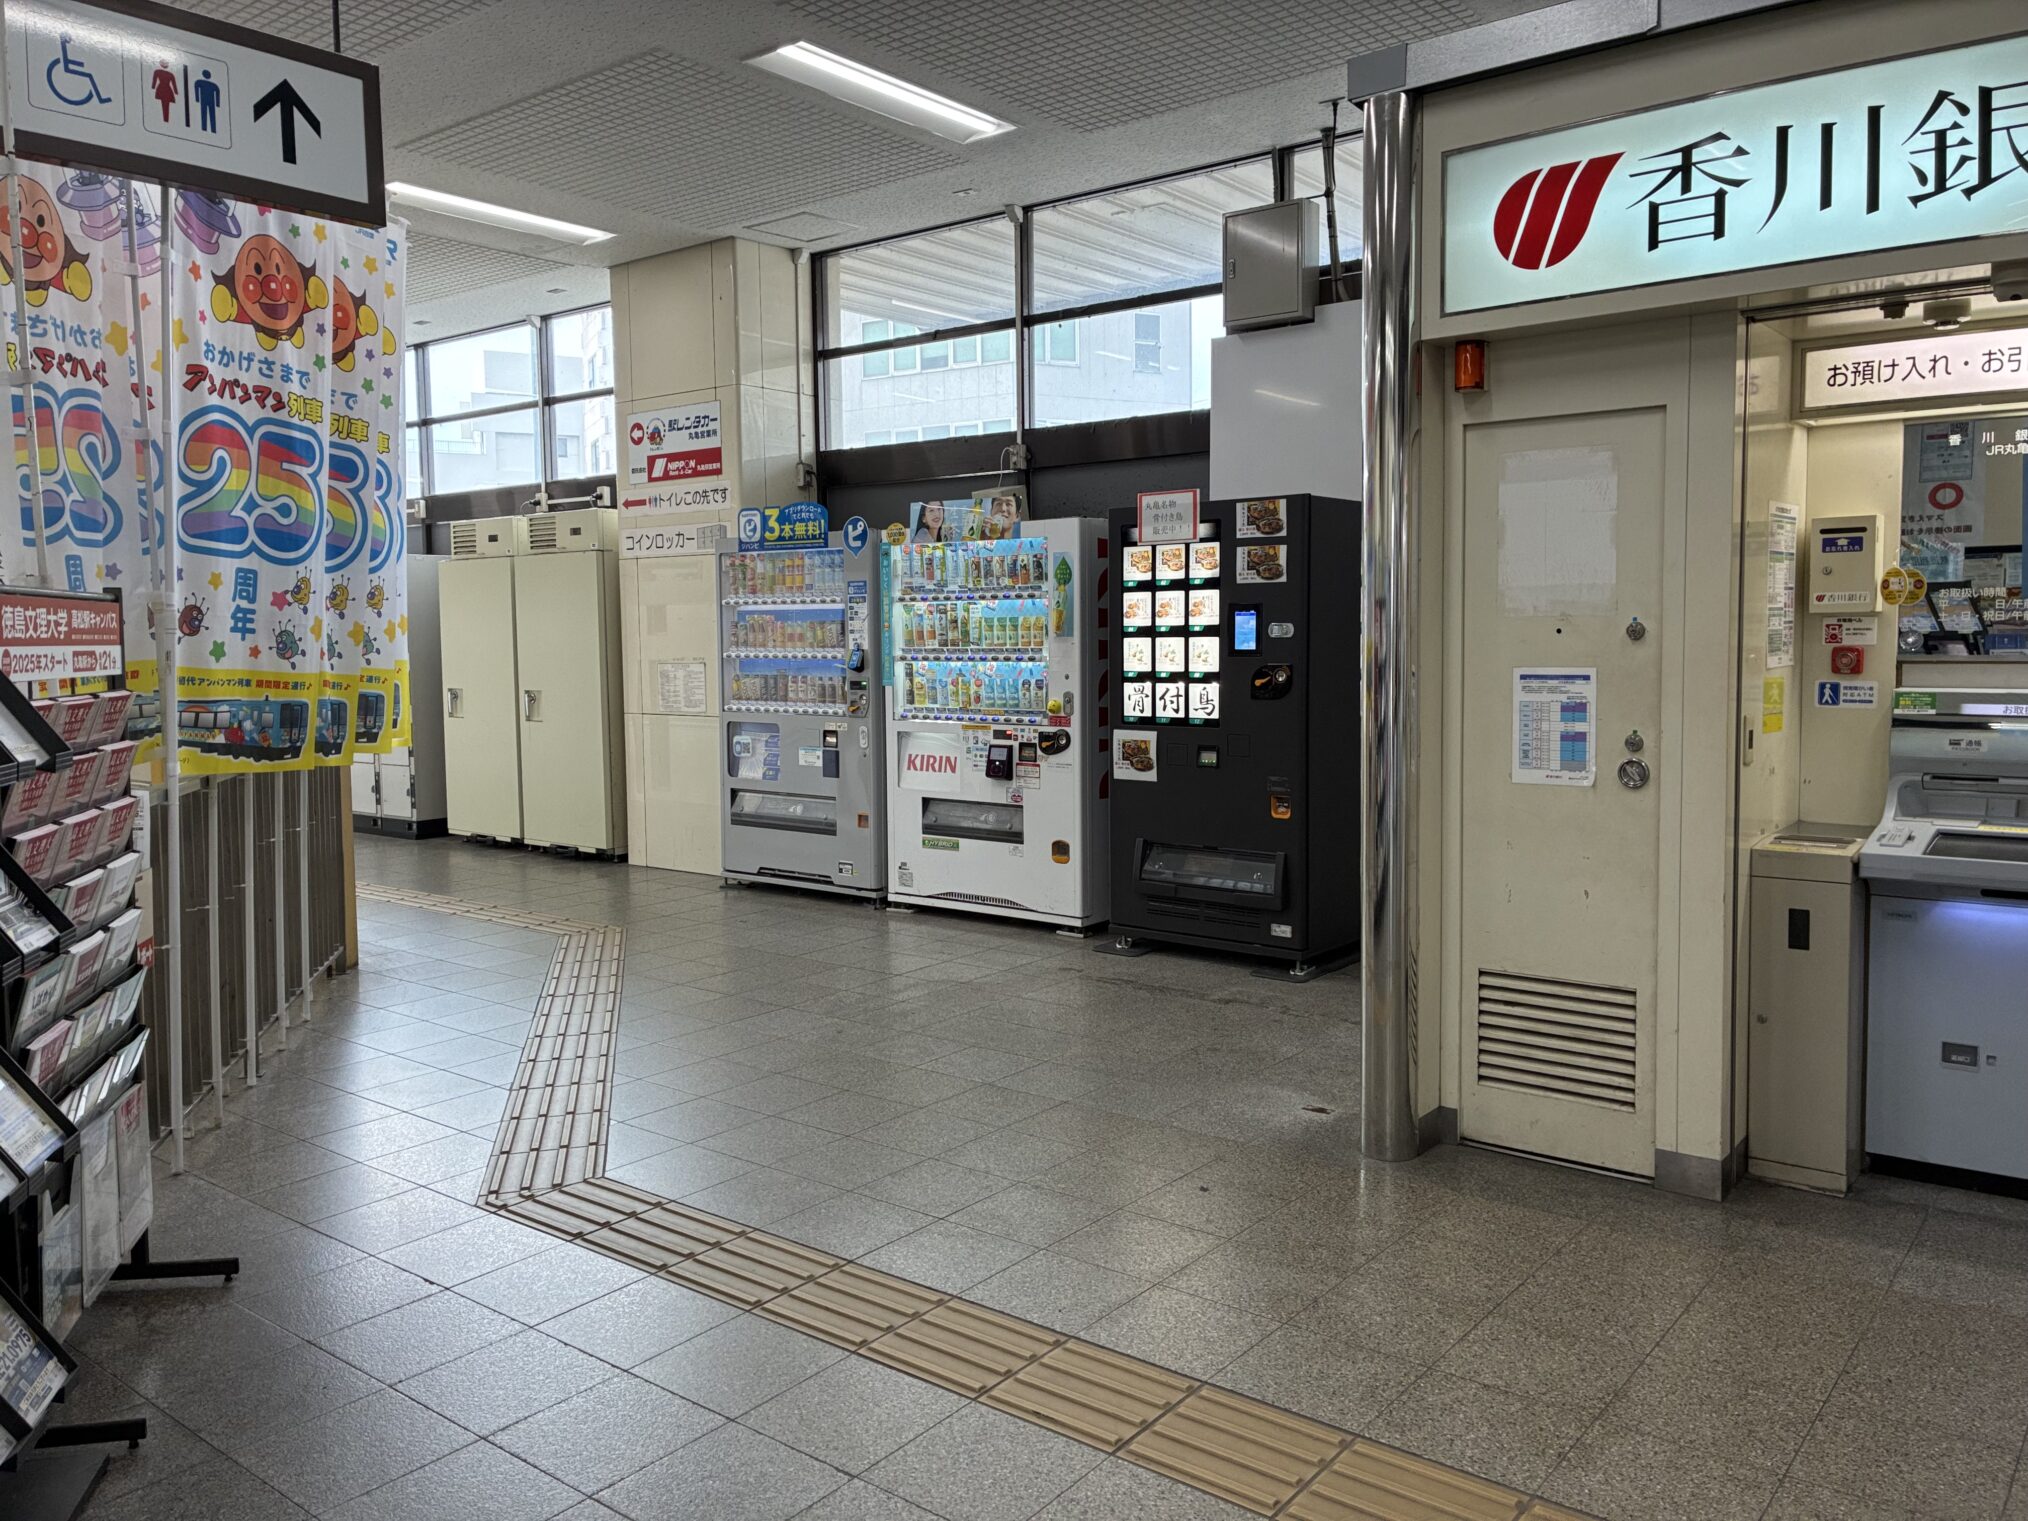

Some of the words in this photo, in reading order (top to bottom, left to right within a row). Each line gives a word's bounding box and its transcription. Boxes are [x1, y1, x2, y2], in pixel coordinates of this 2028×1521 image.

[1626, 83, 2028, 253] 香川銀
[203, 338, 311, 390] おかげさまで
[183, 362, 324, 425] アンパンマン列車
[668, 414, 718, 433] 駅レンタカー
[688, 428, 718, 441] 丸亀営業所
[1981, 431, 1995, 444] 川
[667, 459, 695, 471] NIPPON
[178, 404, 327, 567] 25
[658, 487, 729, 509] トイレこの先です
[625, 531, 696, 551] コインロッカー
[229, 566, 260, 642] 周年
[1, 605, 69, 640] 徳島文理大学
[12, 652, 69, 674] 2025年スタート
[1128, 684, 1150, 714] 骨
[1159, 686, 1184, 715] 付
[1193, 686, 1216, 717] 鳥
[906, 753, 958, 775] KIRIN
